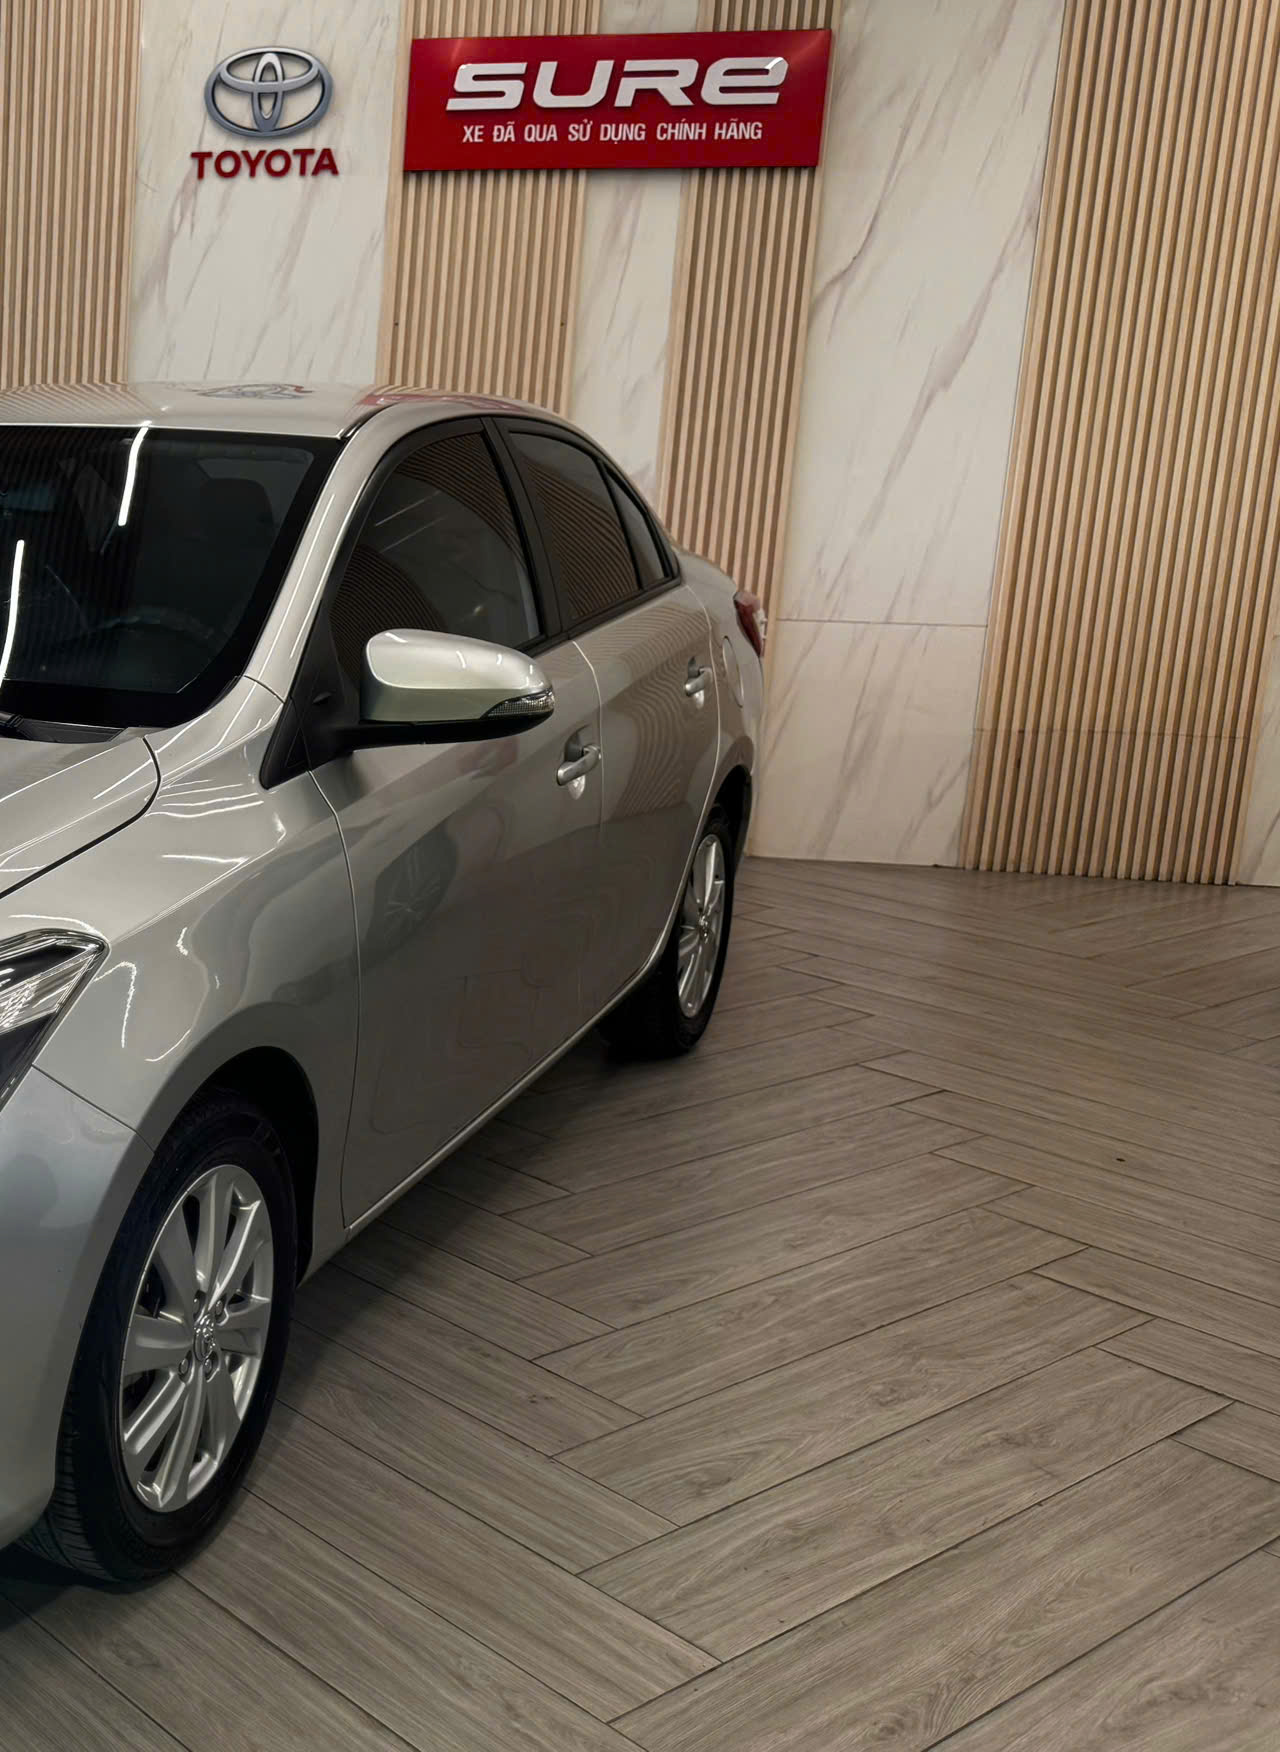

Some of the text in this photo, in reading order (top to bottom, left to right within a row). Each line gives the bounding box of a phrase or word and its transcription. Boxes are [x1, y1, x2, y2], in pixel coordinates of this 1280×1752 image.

[462, 118, 763, 144] XE ĐÃ QUA SỬ DỤNG CHÍNH HÃNG
[191, 147, 339, 180] TOYOTA
